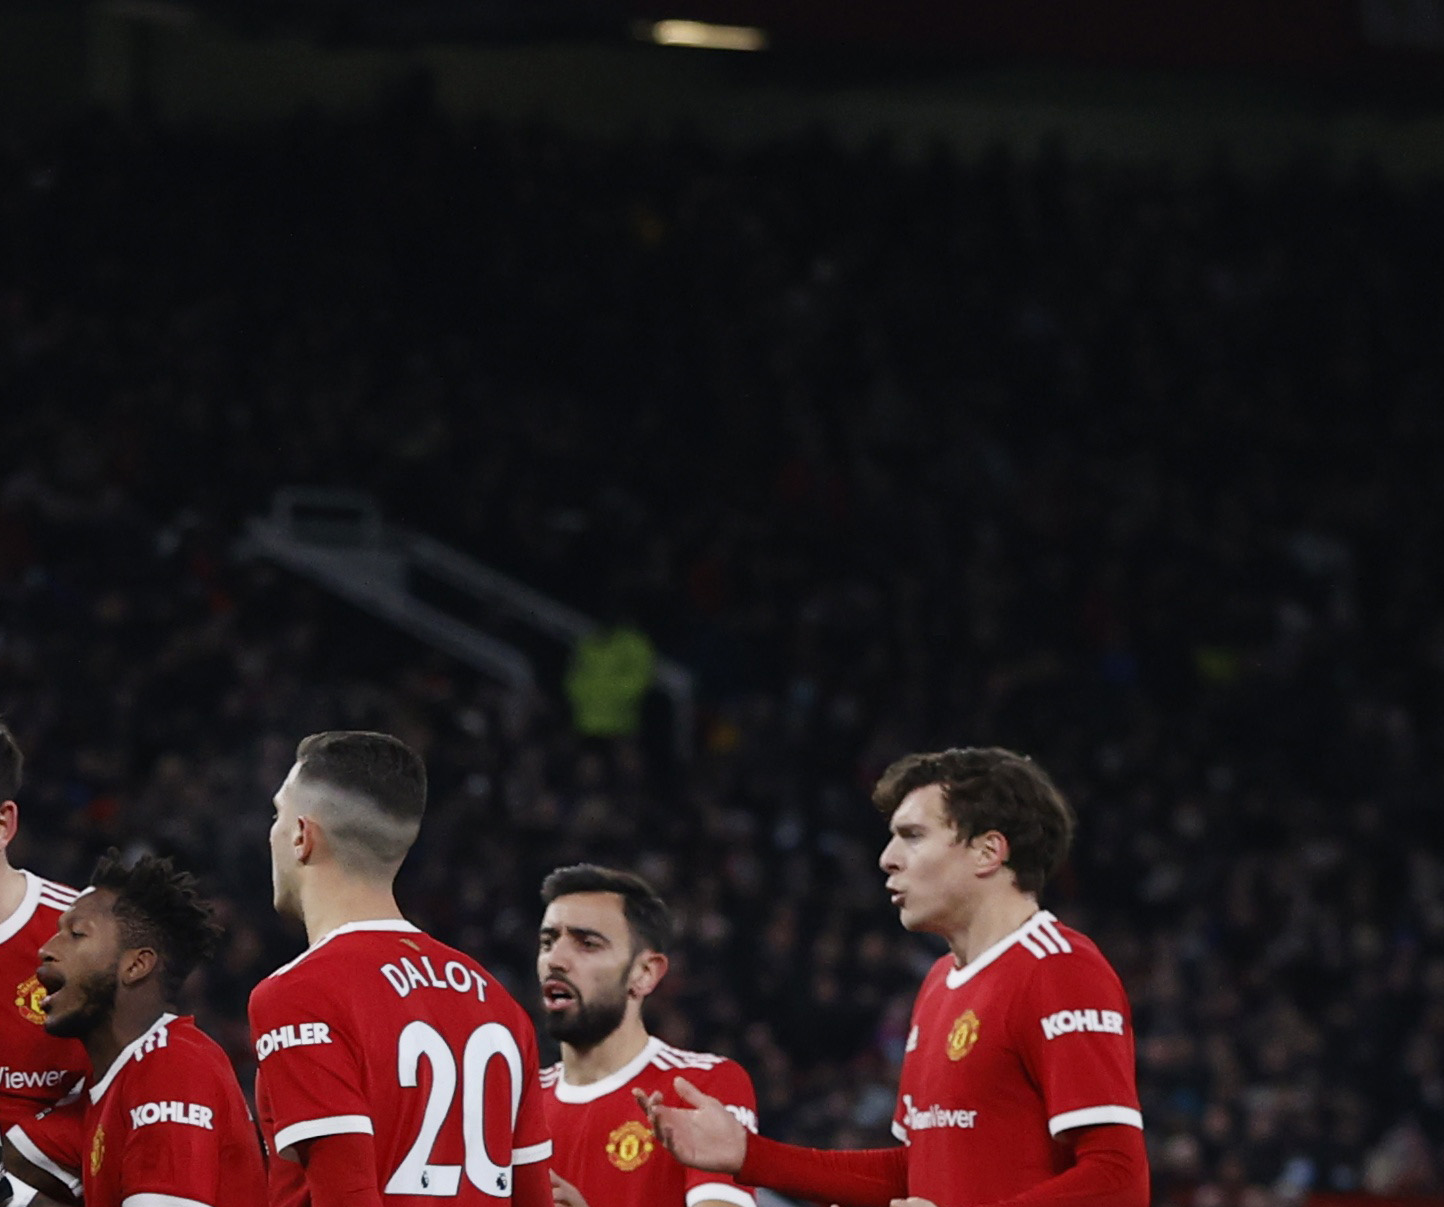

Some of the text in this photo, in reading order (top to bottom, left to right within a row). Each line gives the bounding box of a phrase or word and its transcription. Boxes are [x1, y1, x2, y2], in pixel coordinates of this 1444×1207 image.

[380, 956, 487, 1002] DALOT
[1040, 1009, 1123, 1040] KOHLER
[129, 1100, 214, 1131] KOHLER
[384, 1020, 523, 1198] 20
